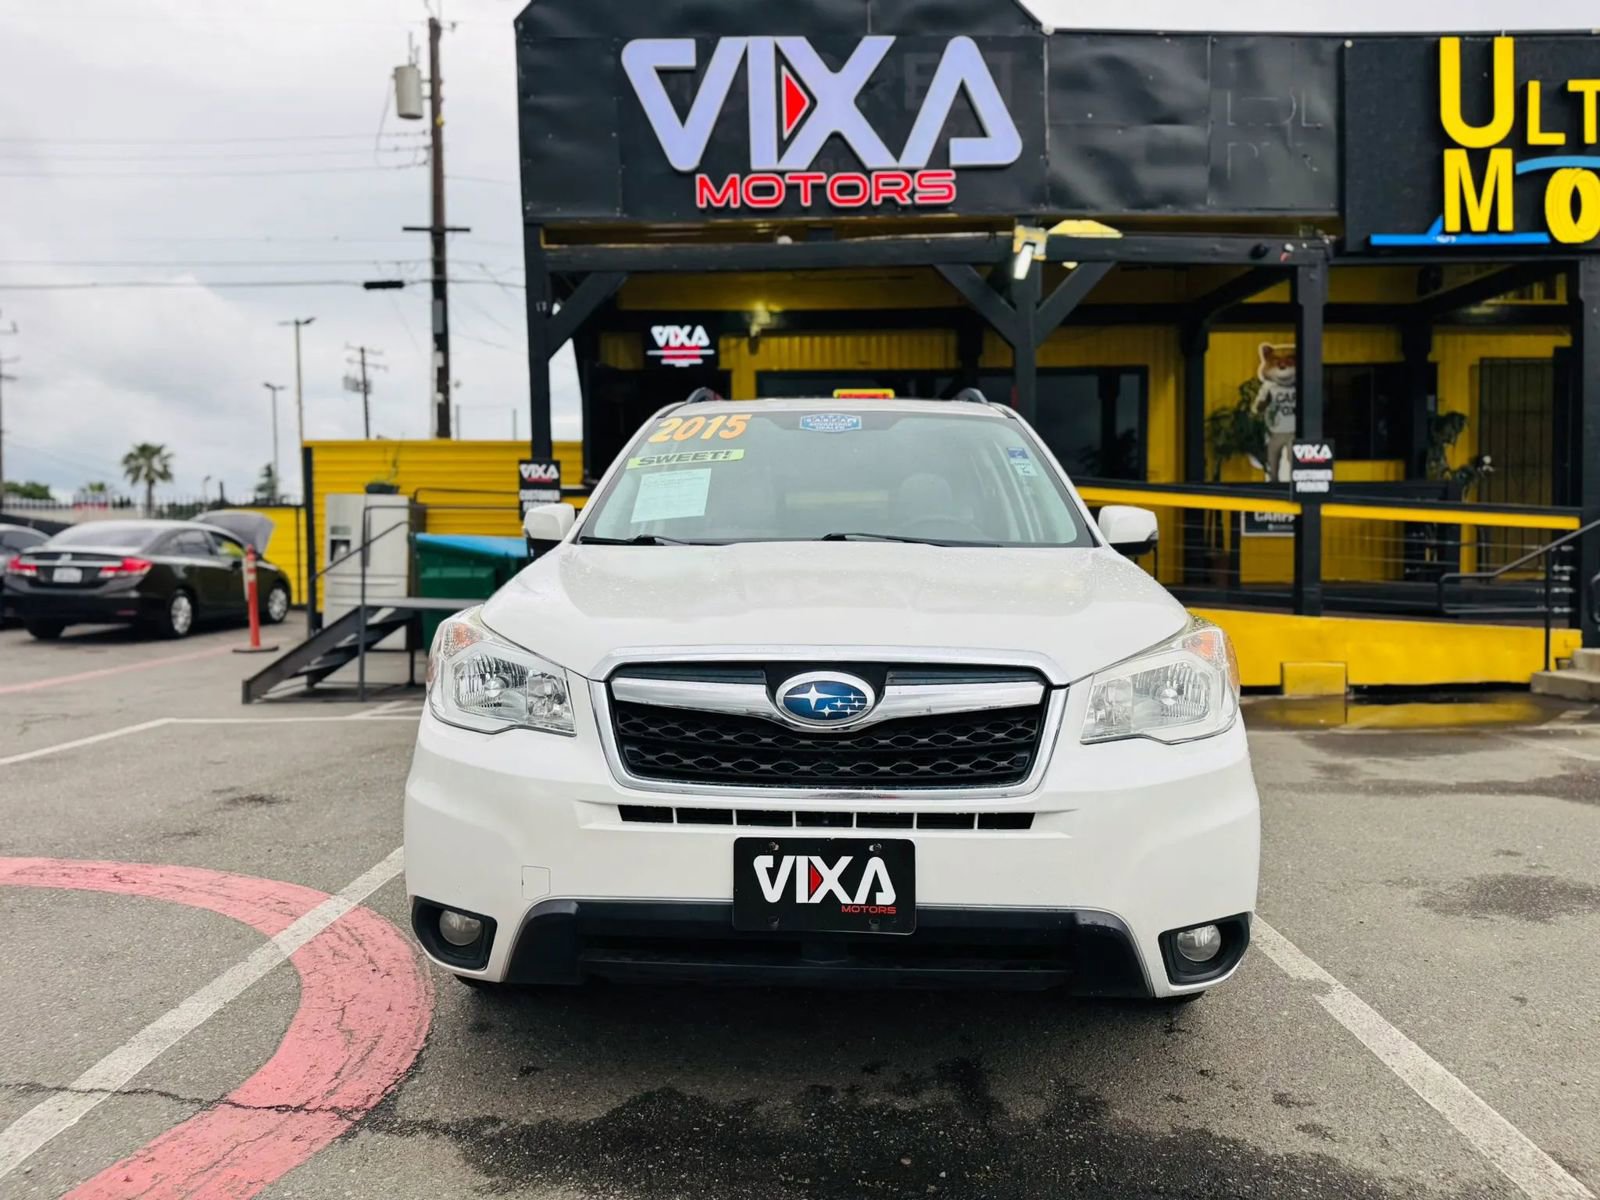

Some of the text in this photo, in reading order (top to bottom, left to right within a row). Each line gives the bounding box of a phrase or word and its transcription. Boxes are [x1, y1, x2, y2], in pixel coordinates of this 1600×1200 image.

[621, 35, 1023, 172] VIXA
[695, 169, 957, 208] MOTORS
[650, 324, 711, 347] VIXA
[647, 414, 753, 443] 2015
[636, 450, 733, 466] SWEET!
[753, 855, 897, 905] VIXA
[841, 905, 897, 915] MOTORS
